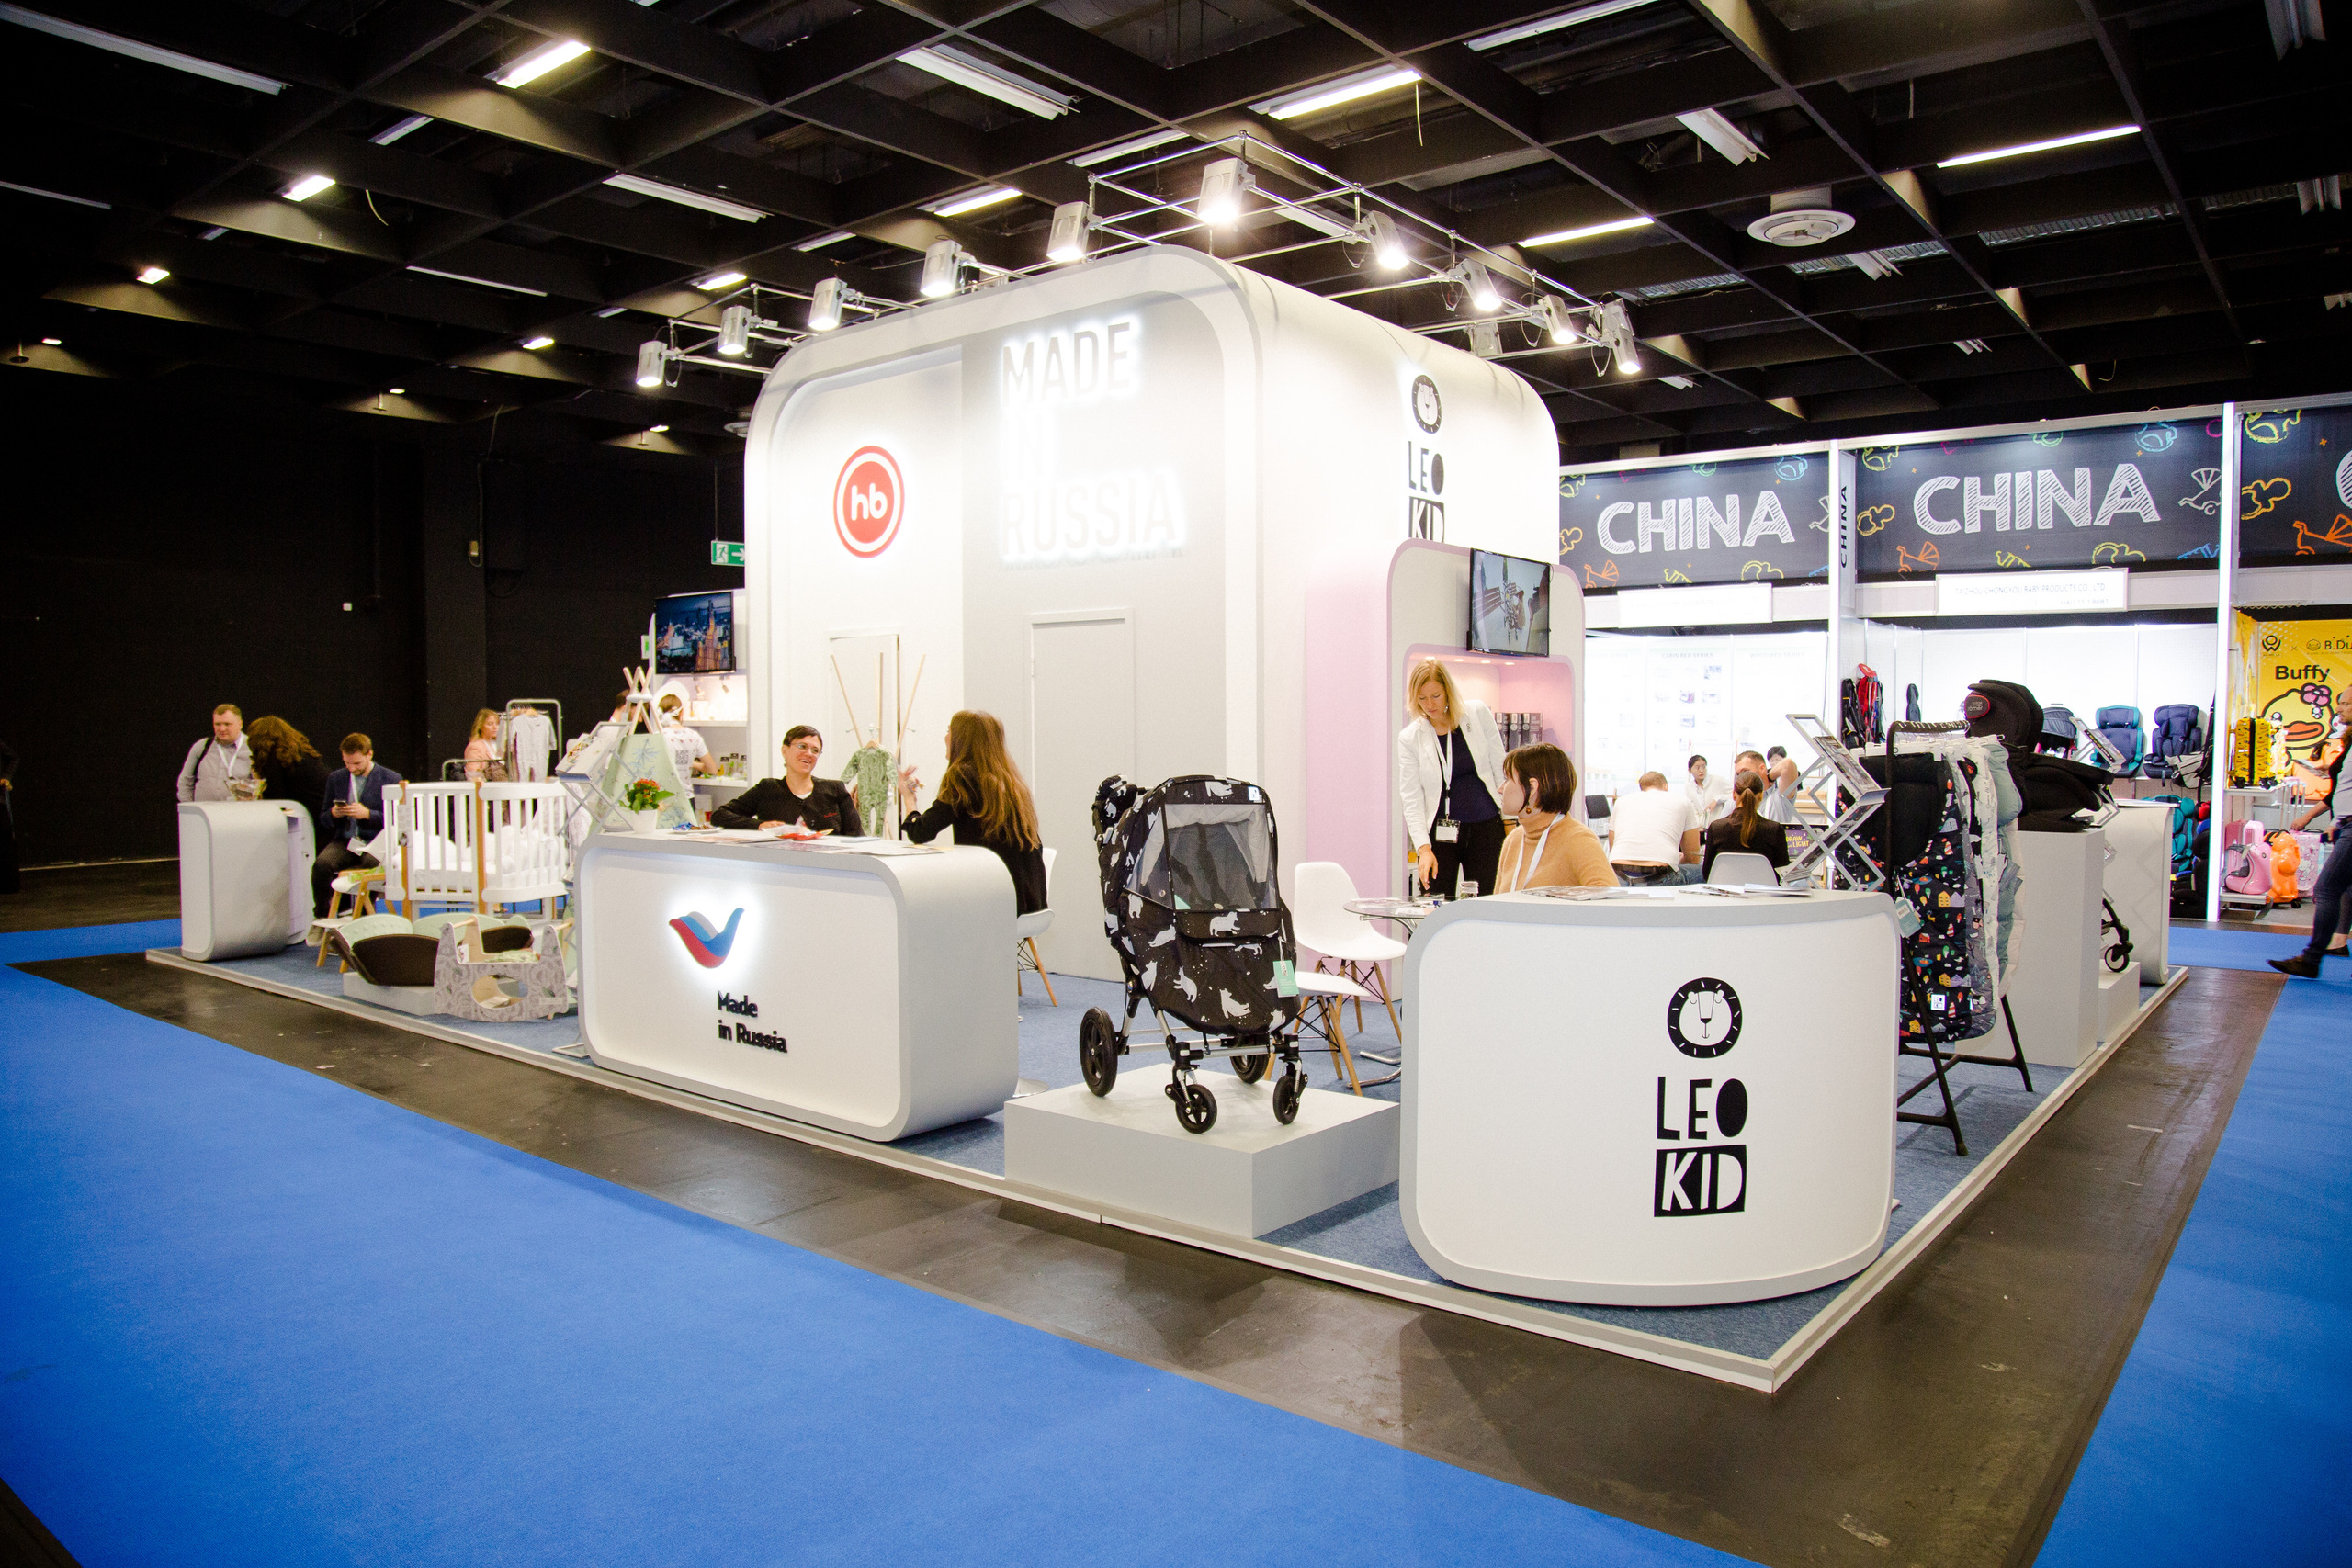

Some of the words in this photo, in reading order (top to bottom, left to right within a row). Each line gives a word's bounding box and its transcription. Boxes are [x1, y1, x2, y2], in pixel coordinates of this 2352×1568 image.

[1002, 321, 1131, 407] MADE
[1002, 409, 1045, 480] IN
[1408, 441, 1444, 496] LEO
[851, 482, 888, 522] hb
[1001, 474, 1177, 556] RUSSIA
[1411, 498, 1445, 544] KID
[1596, 491, 1795, 554] CHINA
[1912, 463, 2161, 535] CHINA
[2024, 584, 2040, 593] BABY
[2041, 583, 2076, 592] PRODUCTS
[2275, 664, 2330, 682] Buffy
[718, 990, 758, 1018] Made
[718, 1019, 732, 1041] in
[736, 1022, 788, 1054] Russia
[1657, 1076, 1748, 1141] LEO
[1661, 1151, 1744, 1212] KID
